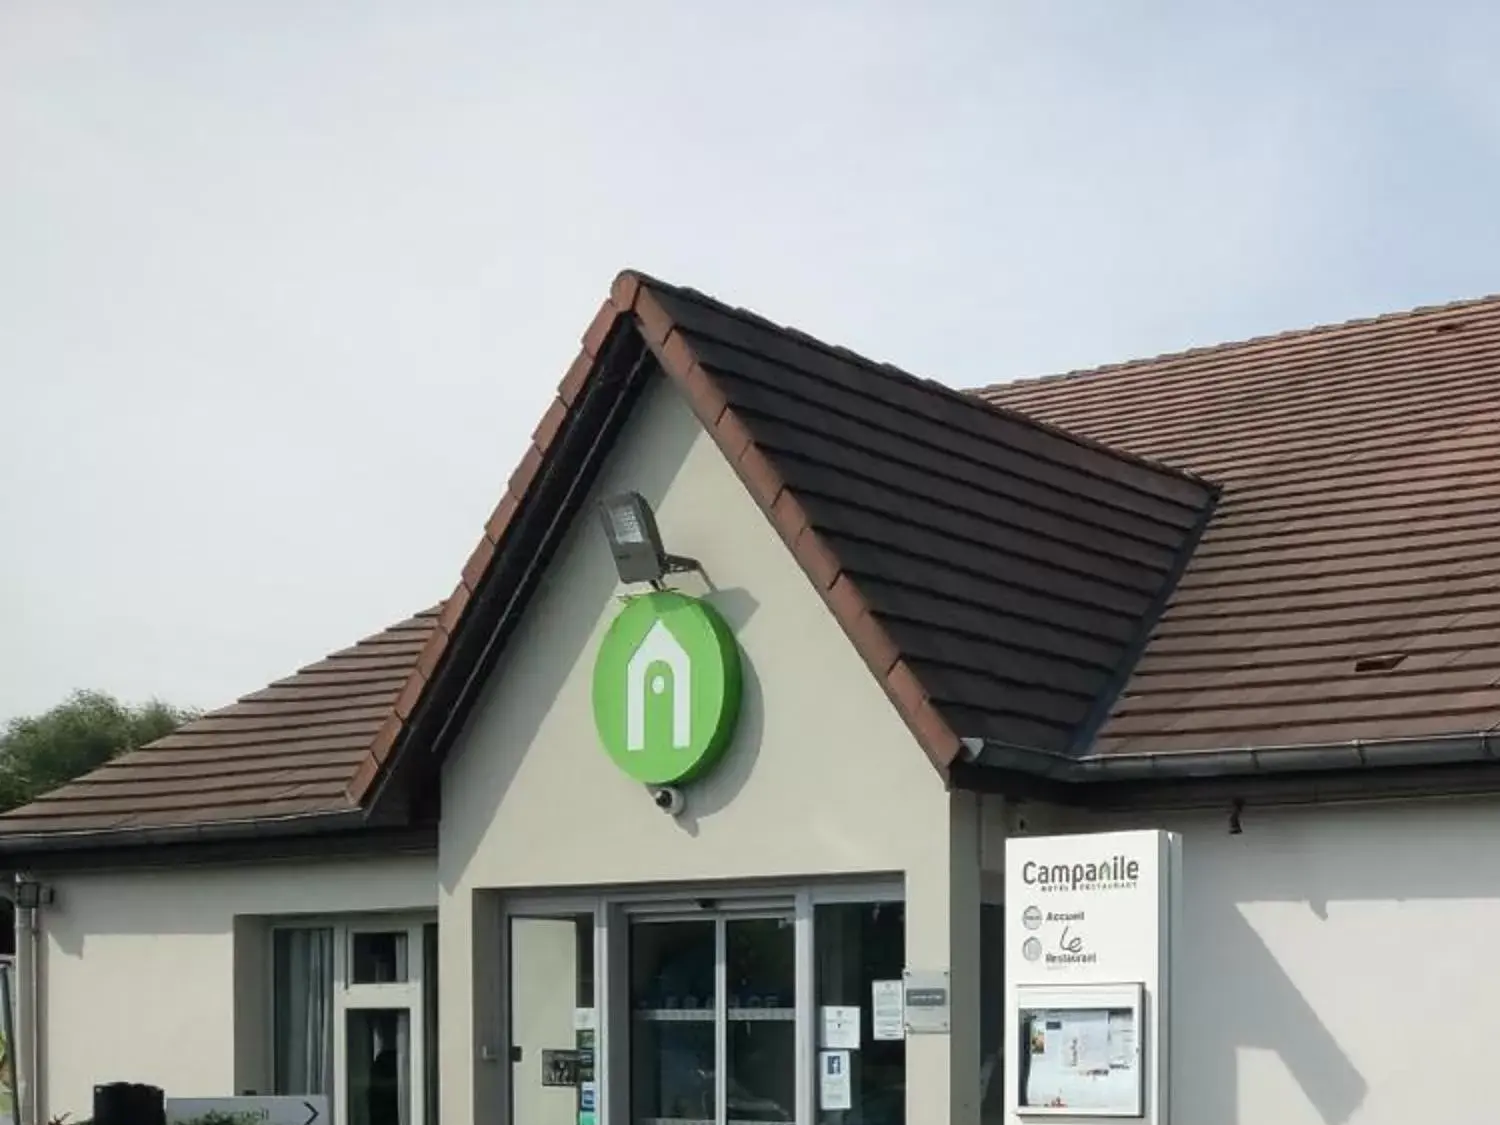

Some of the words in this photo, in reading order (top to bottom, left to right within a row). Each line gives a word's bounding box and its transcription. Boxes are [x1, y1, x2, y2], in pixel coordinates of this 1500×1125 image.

[1023, 855, 1139, 891] Campanile
[1045, 911, 1085, 921] Accueil
[1060, 925, 1083, 953] Le
